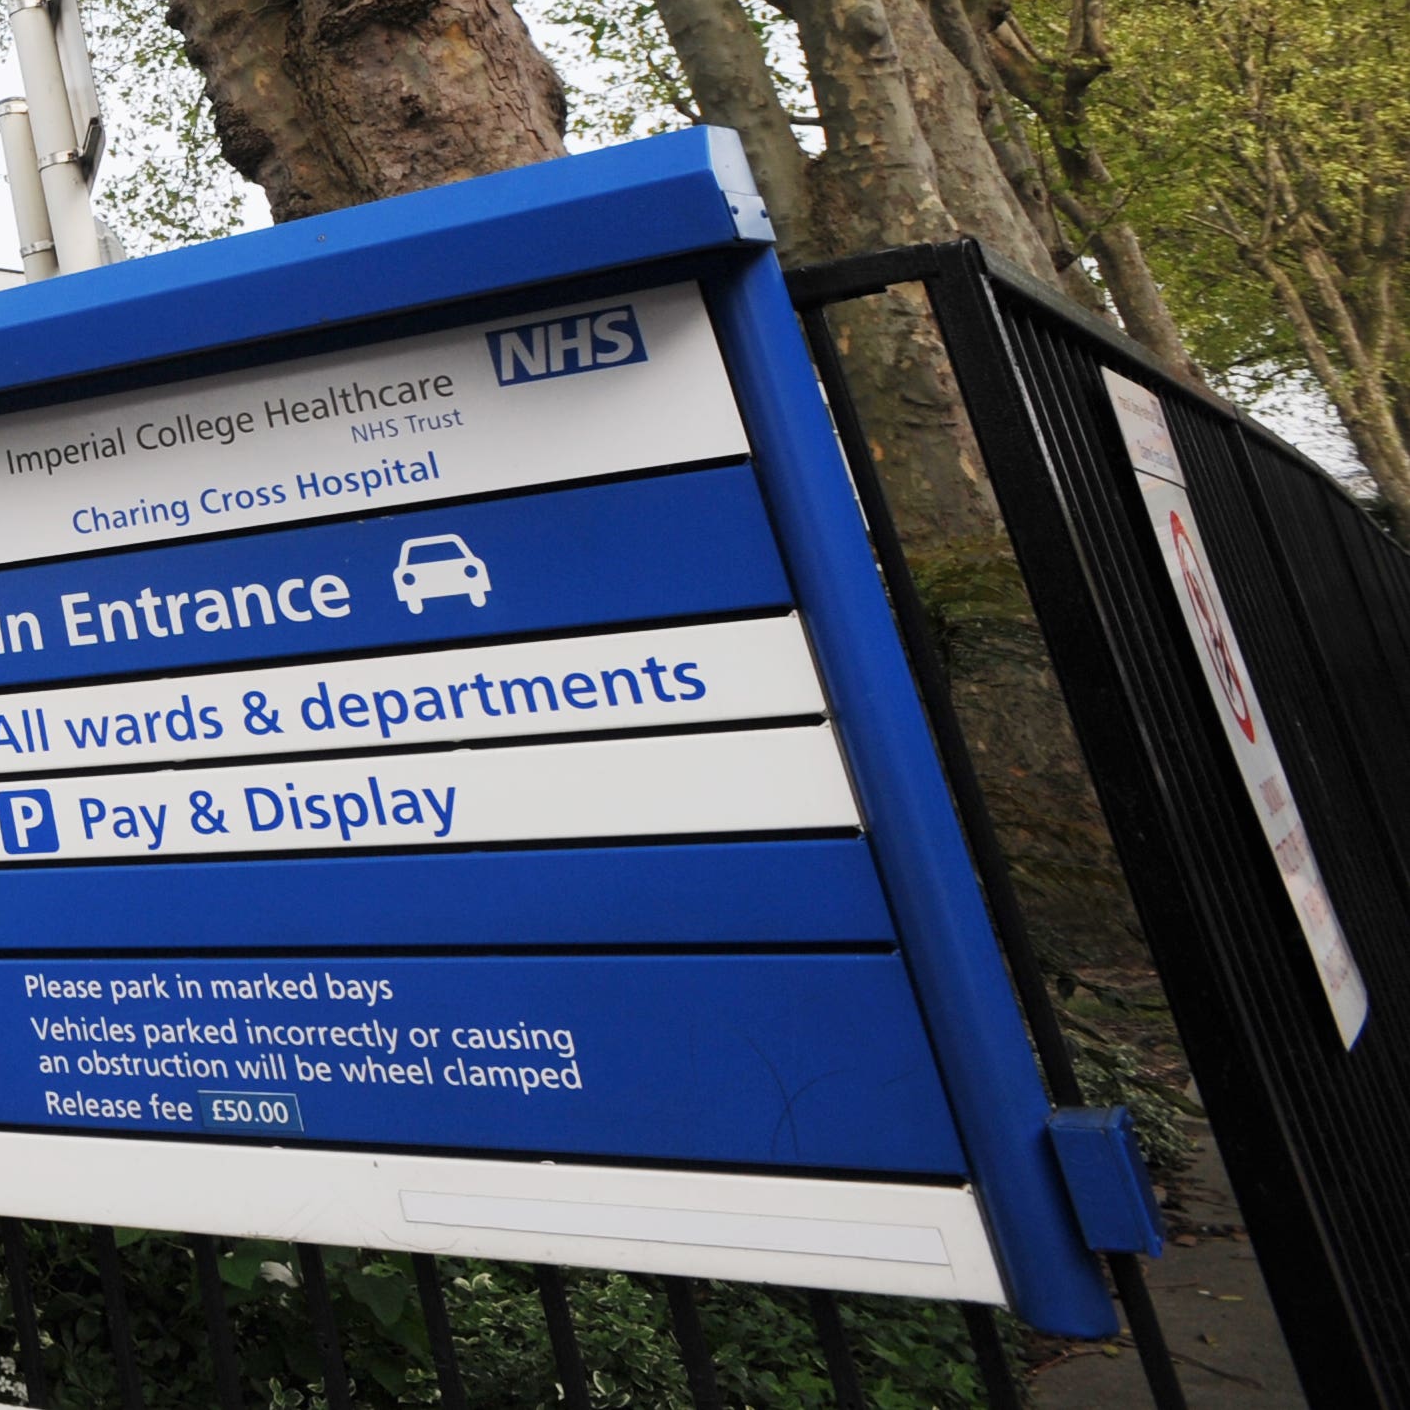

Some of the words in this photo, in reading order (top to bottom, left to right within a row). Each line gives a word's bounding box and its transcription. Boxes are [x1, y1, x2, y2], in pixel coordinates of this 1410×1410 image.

[500, 311, 640, 382] NHS
[5, 426, 126, 475] Imperial
[135, 412, 255, 450] College
[263, 374, 454, 428] Healthcare
[350, 418, 399, 443] NHS
[403, 408, 464, 434] Trust
[72, 498, 190, 534] Charing
[200, 484, 287, 514] Cross
[296, 450, 440, 500] Hospital
[60, 574, 351, 647] Entrance
[64, 694, 224, 749] wards
[242, 690, 284, 736] &
[300, 656, 706, 739] departments
[9, 796, 44, 848] P
[79, 797, 167, 851] Pay
[189, 790, 230, 835] &
[243, 776, 456, 842] Display
[24, 973, 102, 999] Please
[110, 973, 170, 1005] park
[175, 973, 203, 999] in
[210, 972, 318, 1000] marked
[324, 972, 394, 1007] bays
[30, 1016, 137, 1043] Vehicles
[143, 1017, 238, 1049] parked
[244, 1018, 398, 1055] incorrectly
[409, 1027, 441, 1048] or
[451, 1021, 575, 1058] causing
[39, 1054, 70, 1074] an
[77, 1049, 229, 1079] obstruction
[235, 1053, 287, 1080] will
[294, 1054, 332, 1082] be
[339, 1057, 434, 1085] wheel
[443, 1057, 583, 1094] clamped
[45, 1090, 142, 1119] Release
[148, 1093, 193, 1122] fee
[212, 1099, 289, 1124] £50.00
